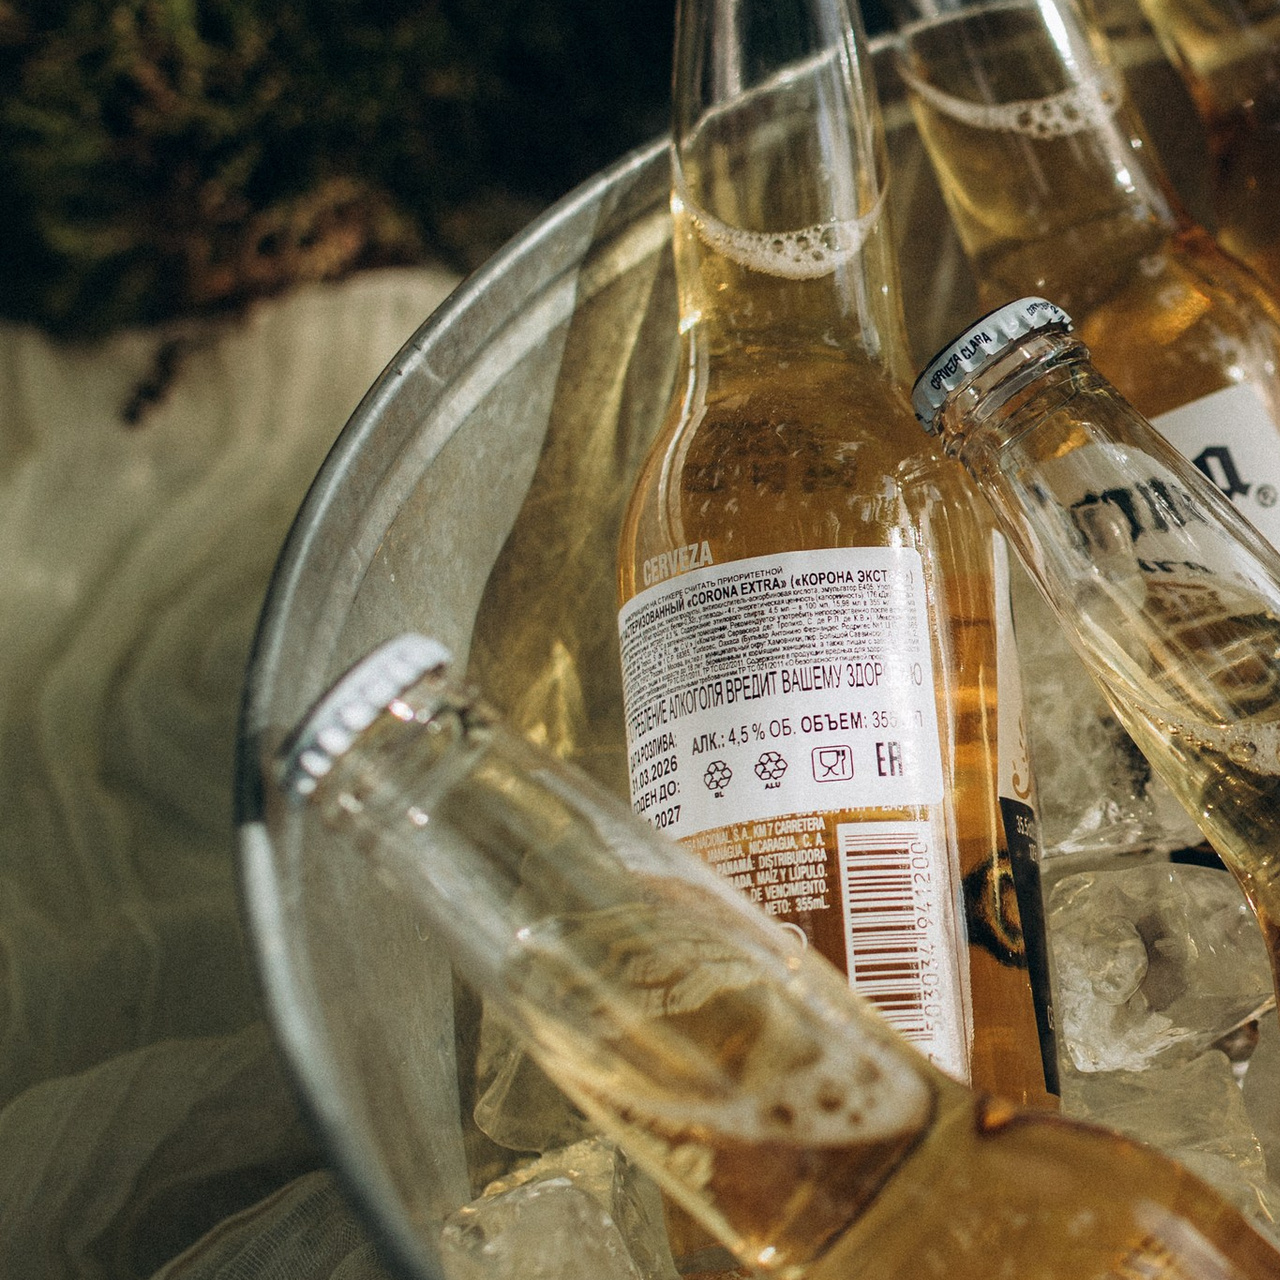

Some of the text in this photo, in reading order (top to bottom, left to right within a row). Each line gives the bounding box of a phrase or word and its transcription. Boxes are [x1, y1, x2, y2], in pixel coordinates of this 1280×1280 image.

[930, 332, 992, 390] CERVEZA CLARA
[643, 540, 714, 587] CERVEZA
[684, 580, 716, 595] СЧИТАТЬ
[717, 566, 783, 587] ПРИОРИТЕТНОЙ
[669, 682, 724, 721] АЛКОГОЛЯ
[726, 672, 777, 704] ВРЕДИТ
[781, 664, 842, 694] ВАШЕМУ
[847, 661, 923, 689] ЗДОРЮ
[728, 724, 749, 747] 4,5
[751, 722, 766, 741] %
[769, 717, 797, 738] ОБ.
[800, 711, 868, 734] ОБЪЕМ:
[640, 731, 678, 765] РОЗЛИВА:
[659, 780, 681, 803] ДО:
[765, 781, 780, 790] ALU
[774, 816, 826, 835] CARRETERA
[758, 846, 828, 870] DISTRIBUIDORA
[779, 868, 787, 882] Y
[788, 862, 828, 882] LÚPULO.
[764, 878, 829, 900] VENCIMIENTO.
[909, 841, 933, 930] 941200
